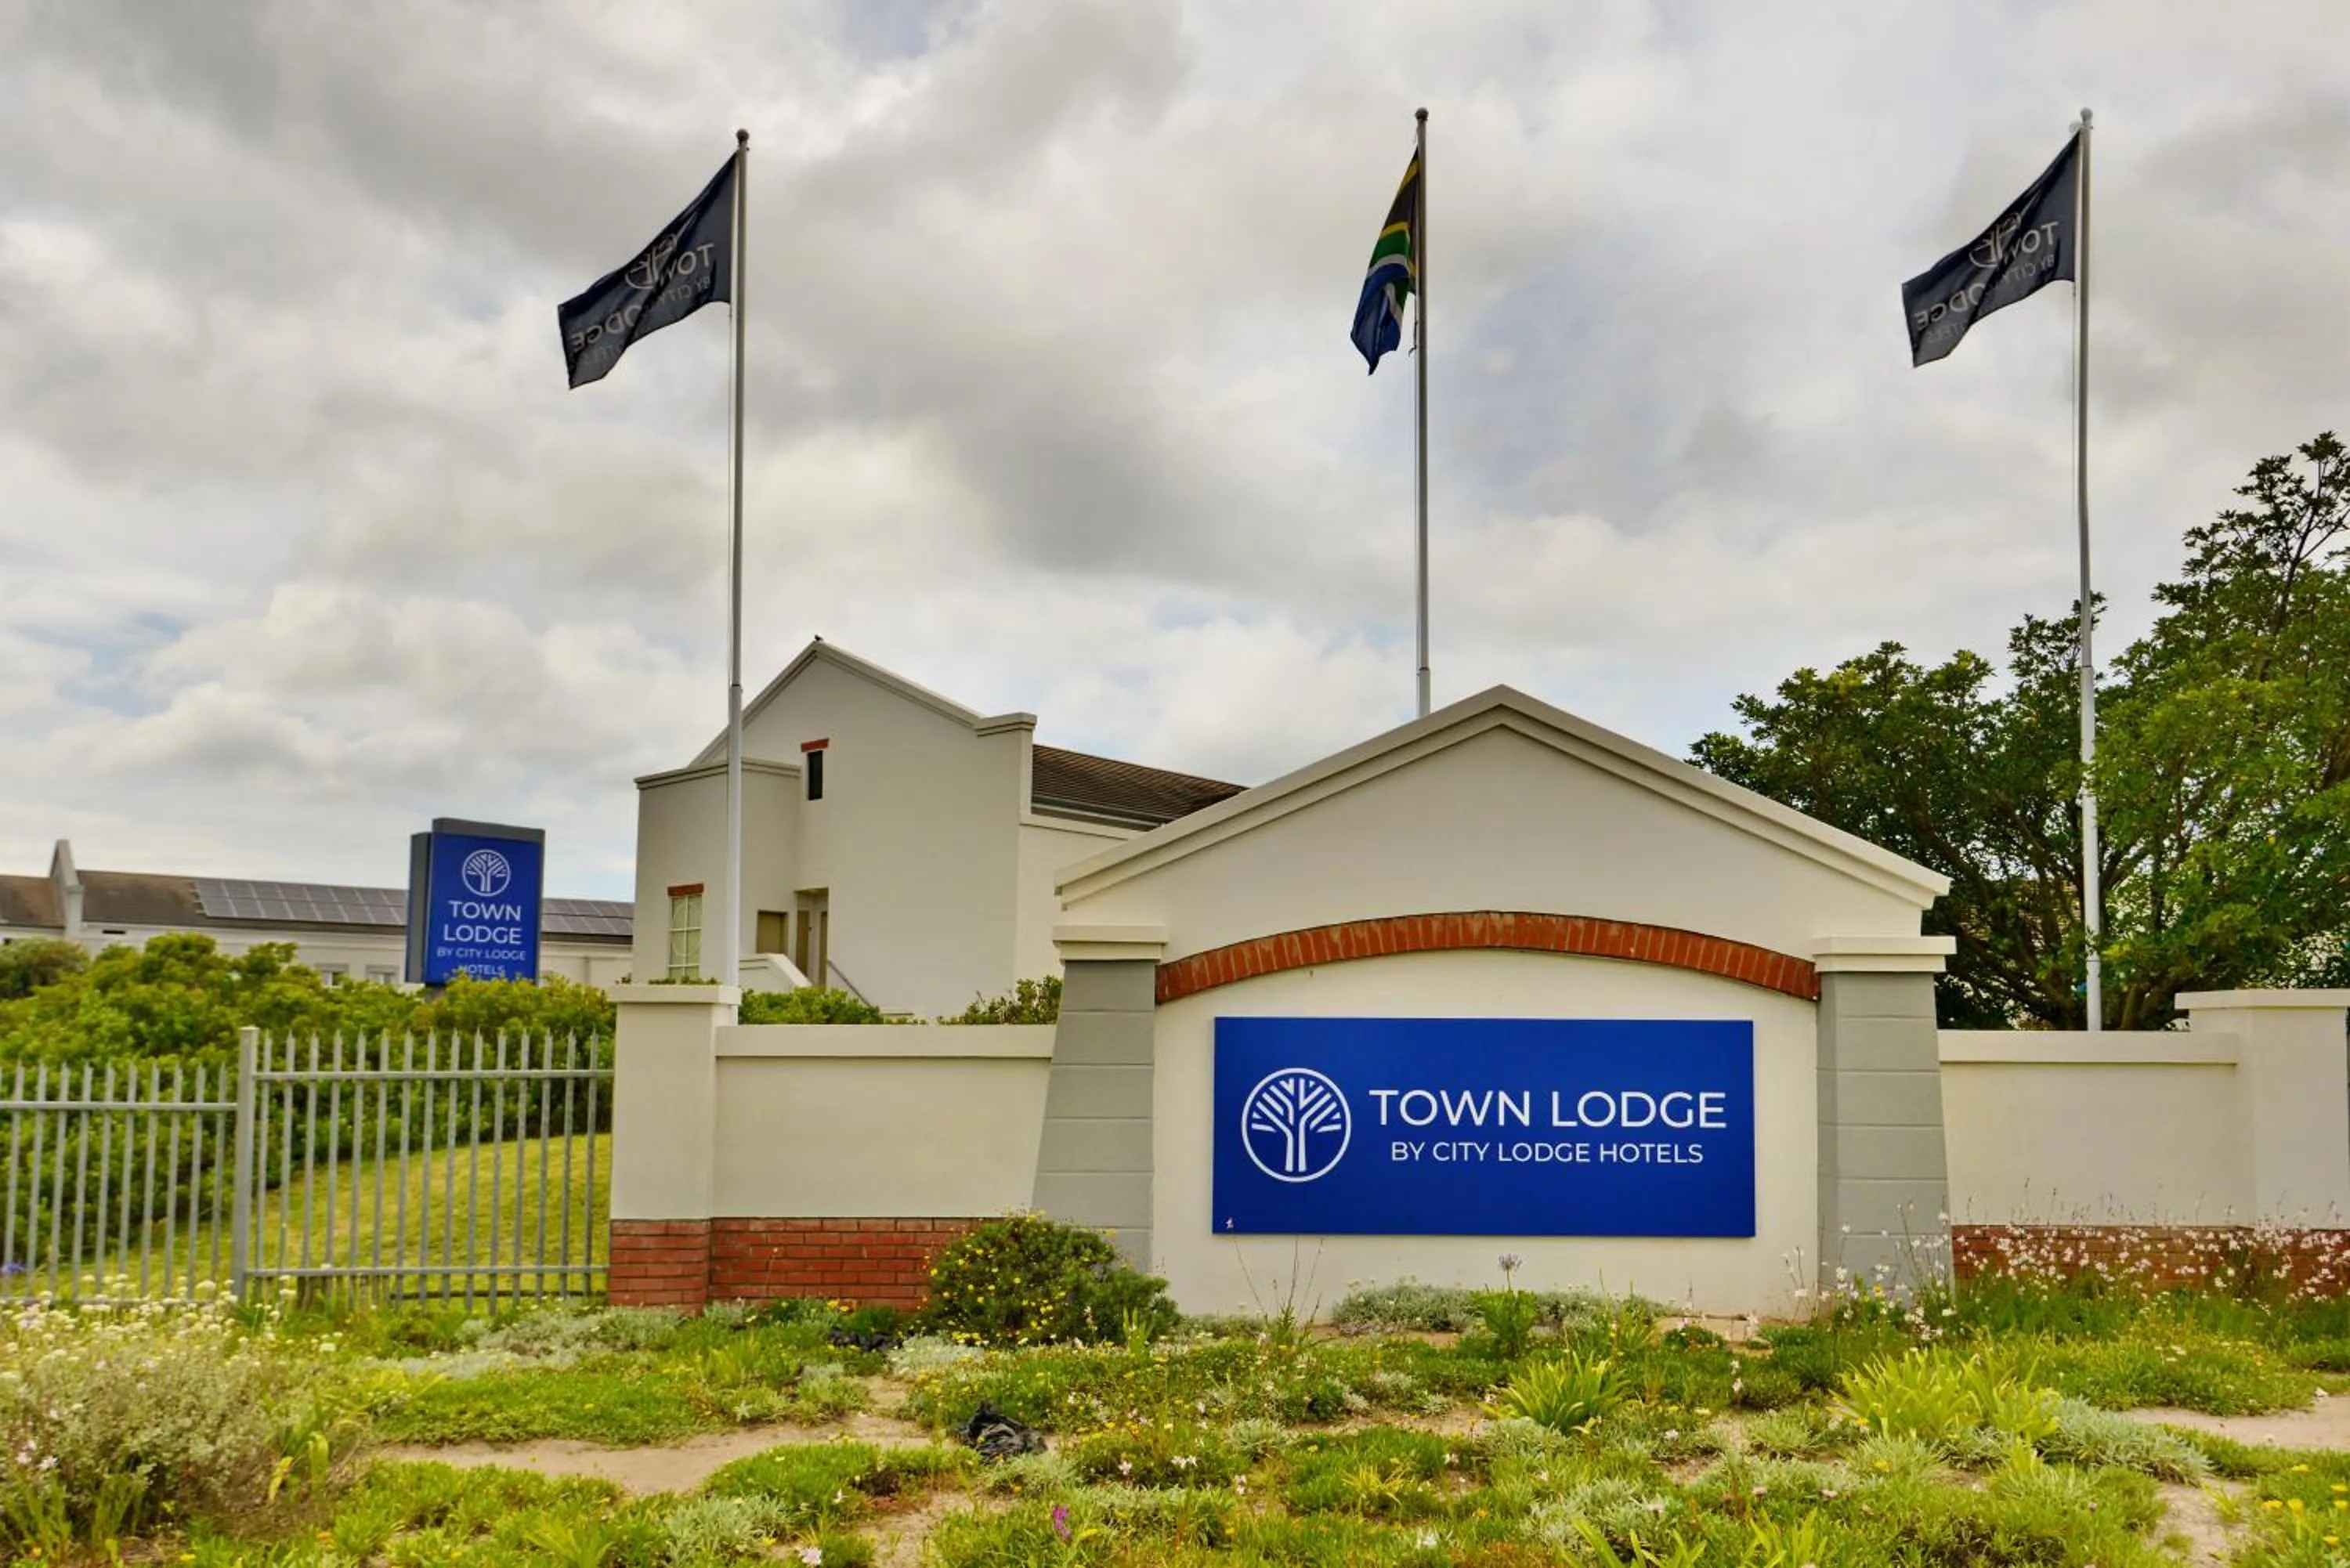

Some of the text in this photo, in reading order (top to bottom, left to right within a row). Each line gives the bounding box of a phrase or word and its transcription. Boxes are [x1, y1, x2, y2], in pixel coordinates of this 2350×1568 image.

[448, 900, 522, 922] TOWN
[443, 923, 523, 945] LODGE
[437, 946, 526, 960] BY CITY LODGE
[1368, 1089, 1728, 1129] TOWN LODGE
[1391, 1141, 1705, 1164] BY CITY LODGE HOTELS
